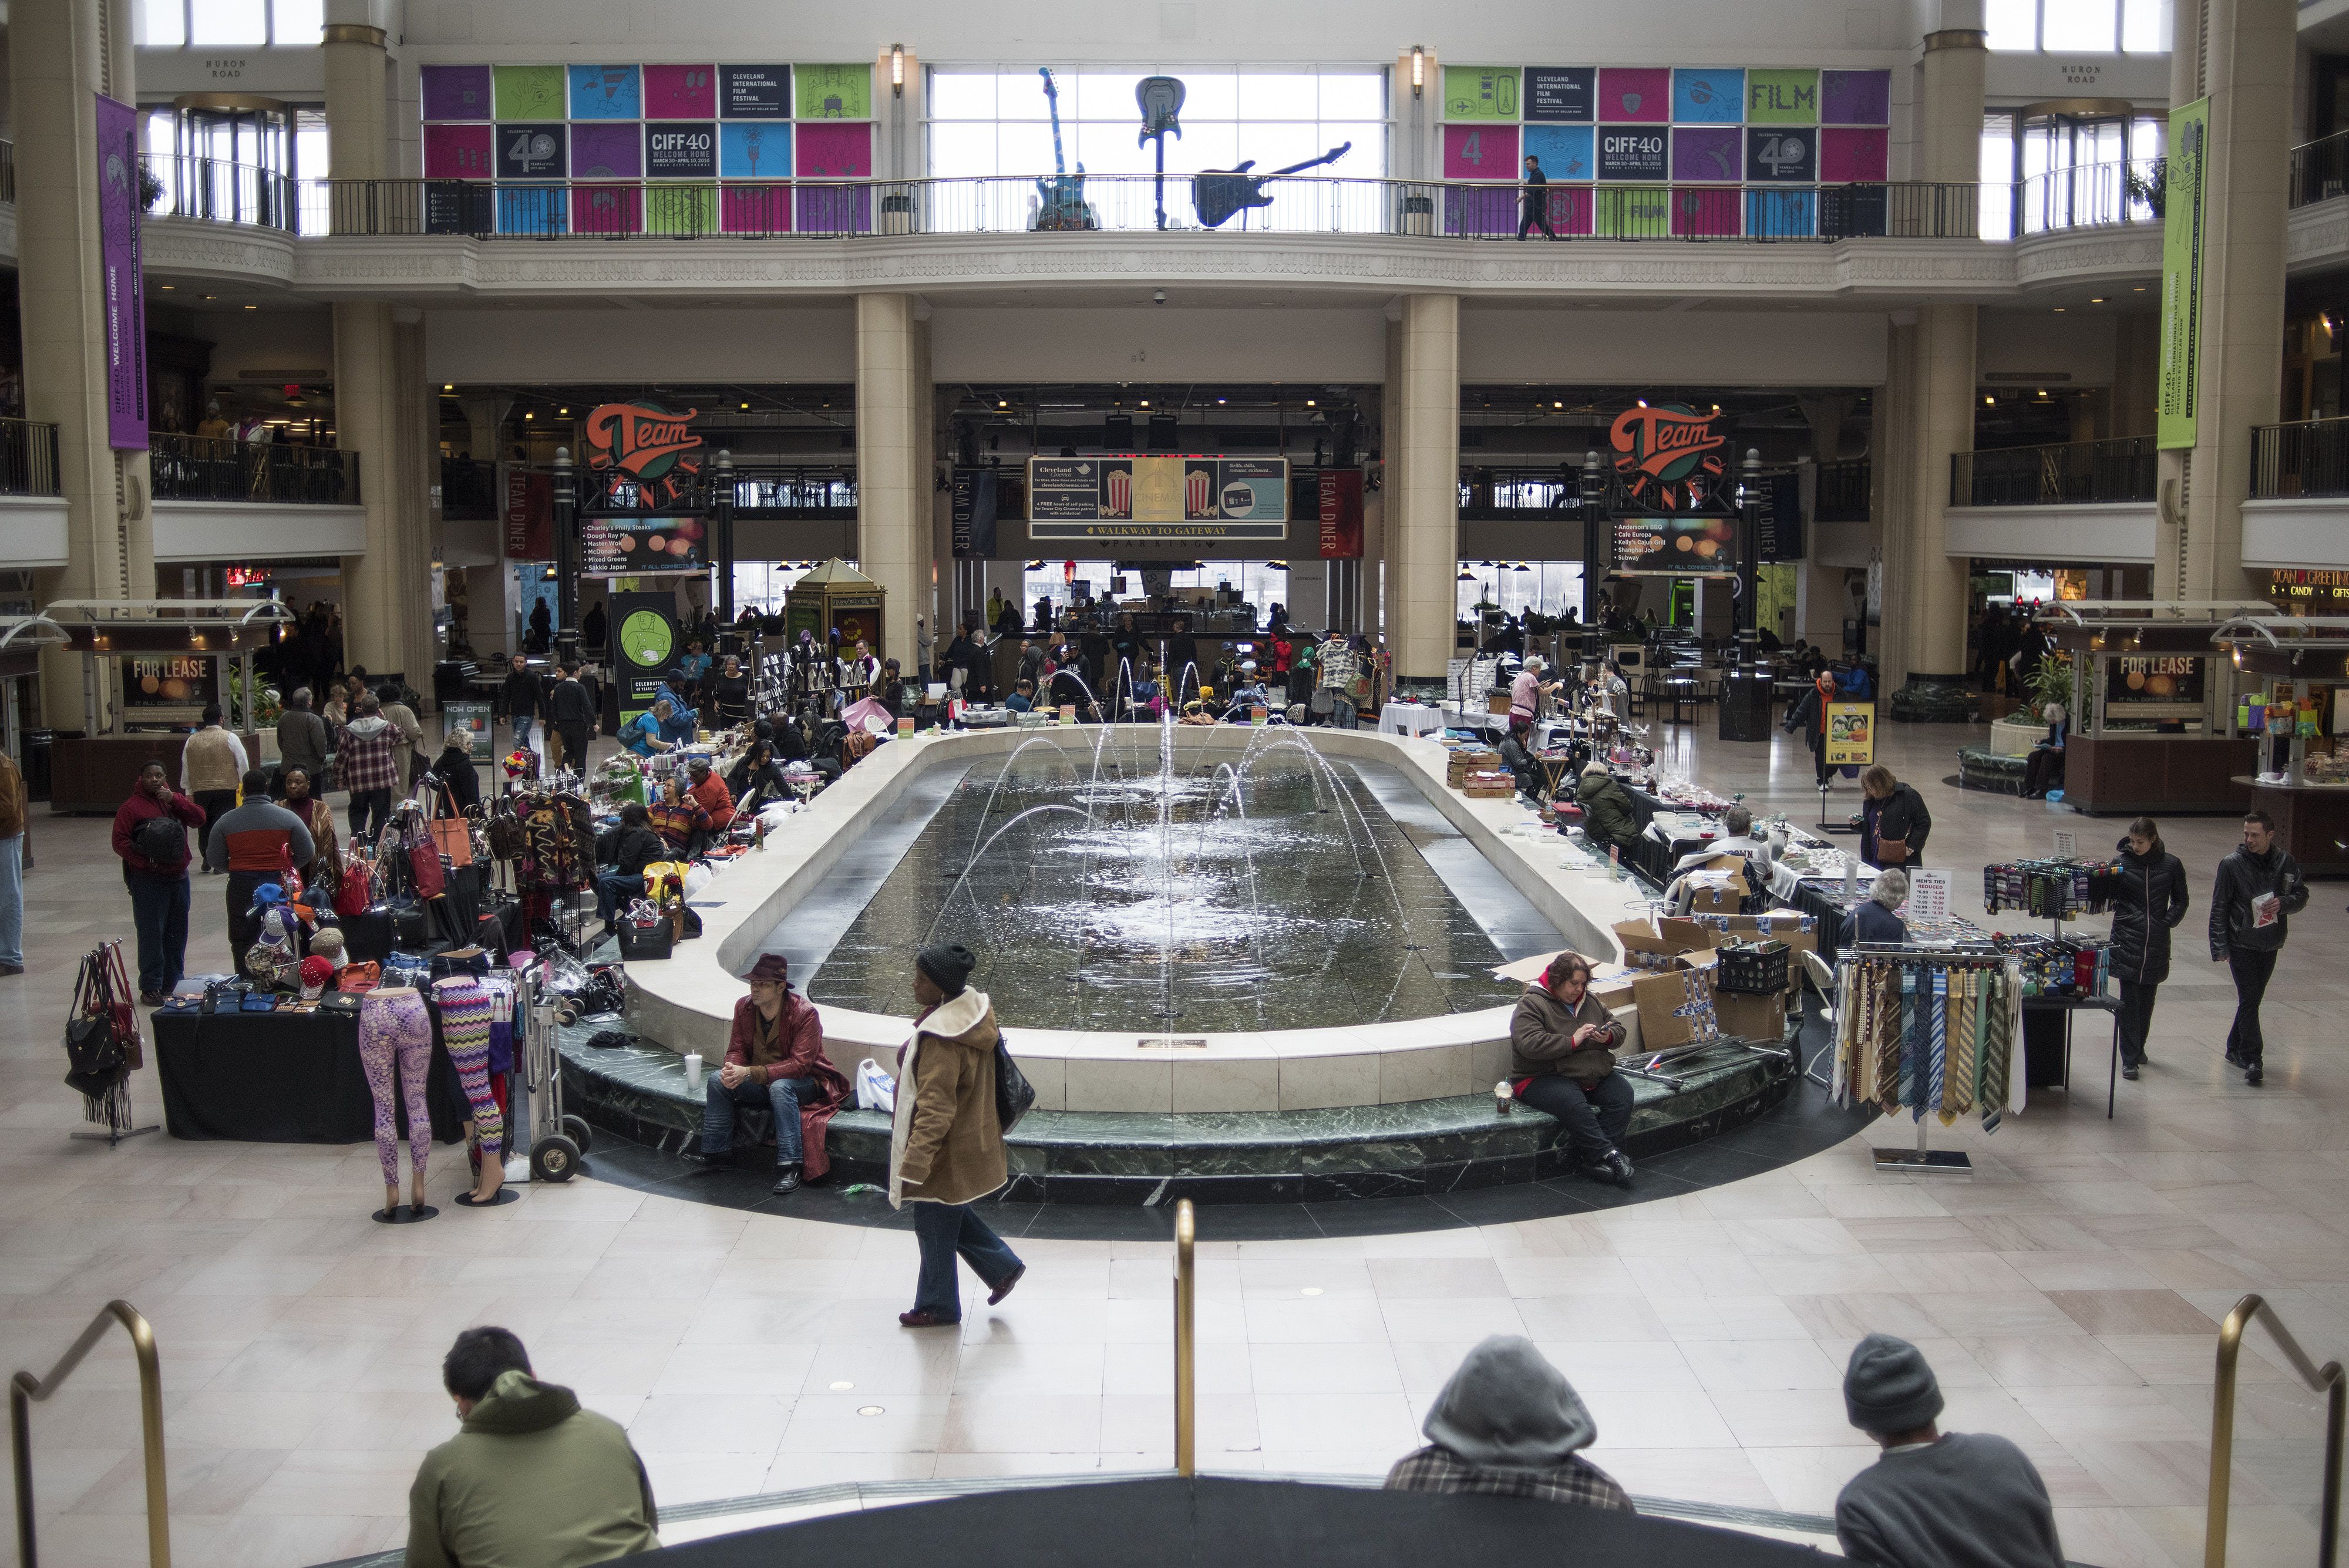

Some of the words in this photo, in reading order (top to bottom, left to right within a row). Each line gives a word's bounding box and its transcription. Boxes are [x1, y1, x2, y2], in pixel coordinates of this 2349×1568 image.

[1751, 85, 1814, 110] FILM
[508, 134, 556, 173] 40
[1461, 132, 1483, 165] 4
[1758, 137, 1805, 176] 40
[1631, 206, 1666, 218] FILM
[2178, 365, 2182, 374] BY
[2190, 352, 2193, 361] 40
[587, 403, 701, 457] Team
[1610, 407, 1726, 459] Team
[510, 476, 526, 508] TEAM
[589, 453, 701, 509] DINER
[955, 475, 970, 507] TEAM
[1321, 475, 1335, 507] TEAM
[1615, 455, 1727, 511] DINER
[1135, 493, 1184, 503] CINEMAS
[510, 514, 525, 550] DINER
[955, 514, 970, 549] DINER
[1097, 527, 1152, 535] WALKWAY
[1176, 527, 1227, 535] GATEWAY
[1321, 514, 1336, 550] DINER
[1761, 518, 1775, 553] DINER
[2291, 586, 2313, 596] CANDY
[133, 661, 160, 678] FOR
[164, 660, 207, 678] LEASE
[2121, 657, 2146, 674] FOR
[2151, 657, 2194, 674] LEASE
